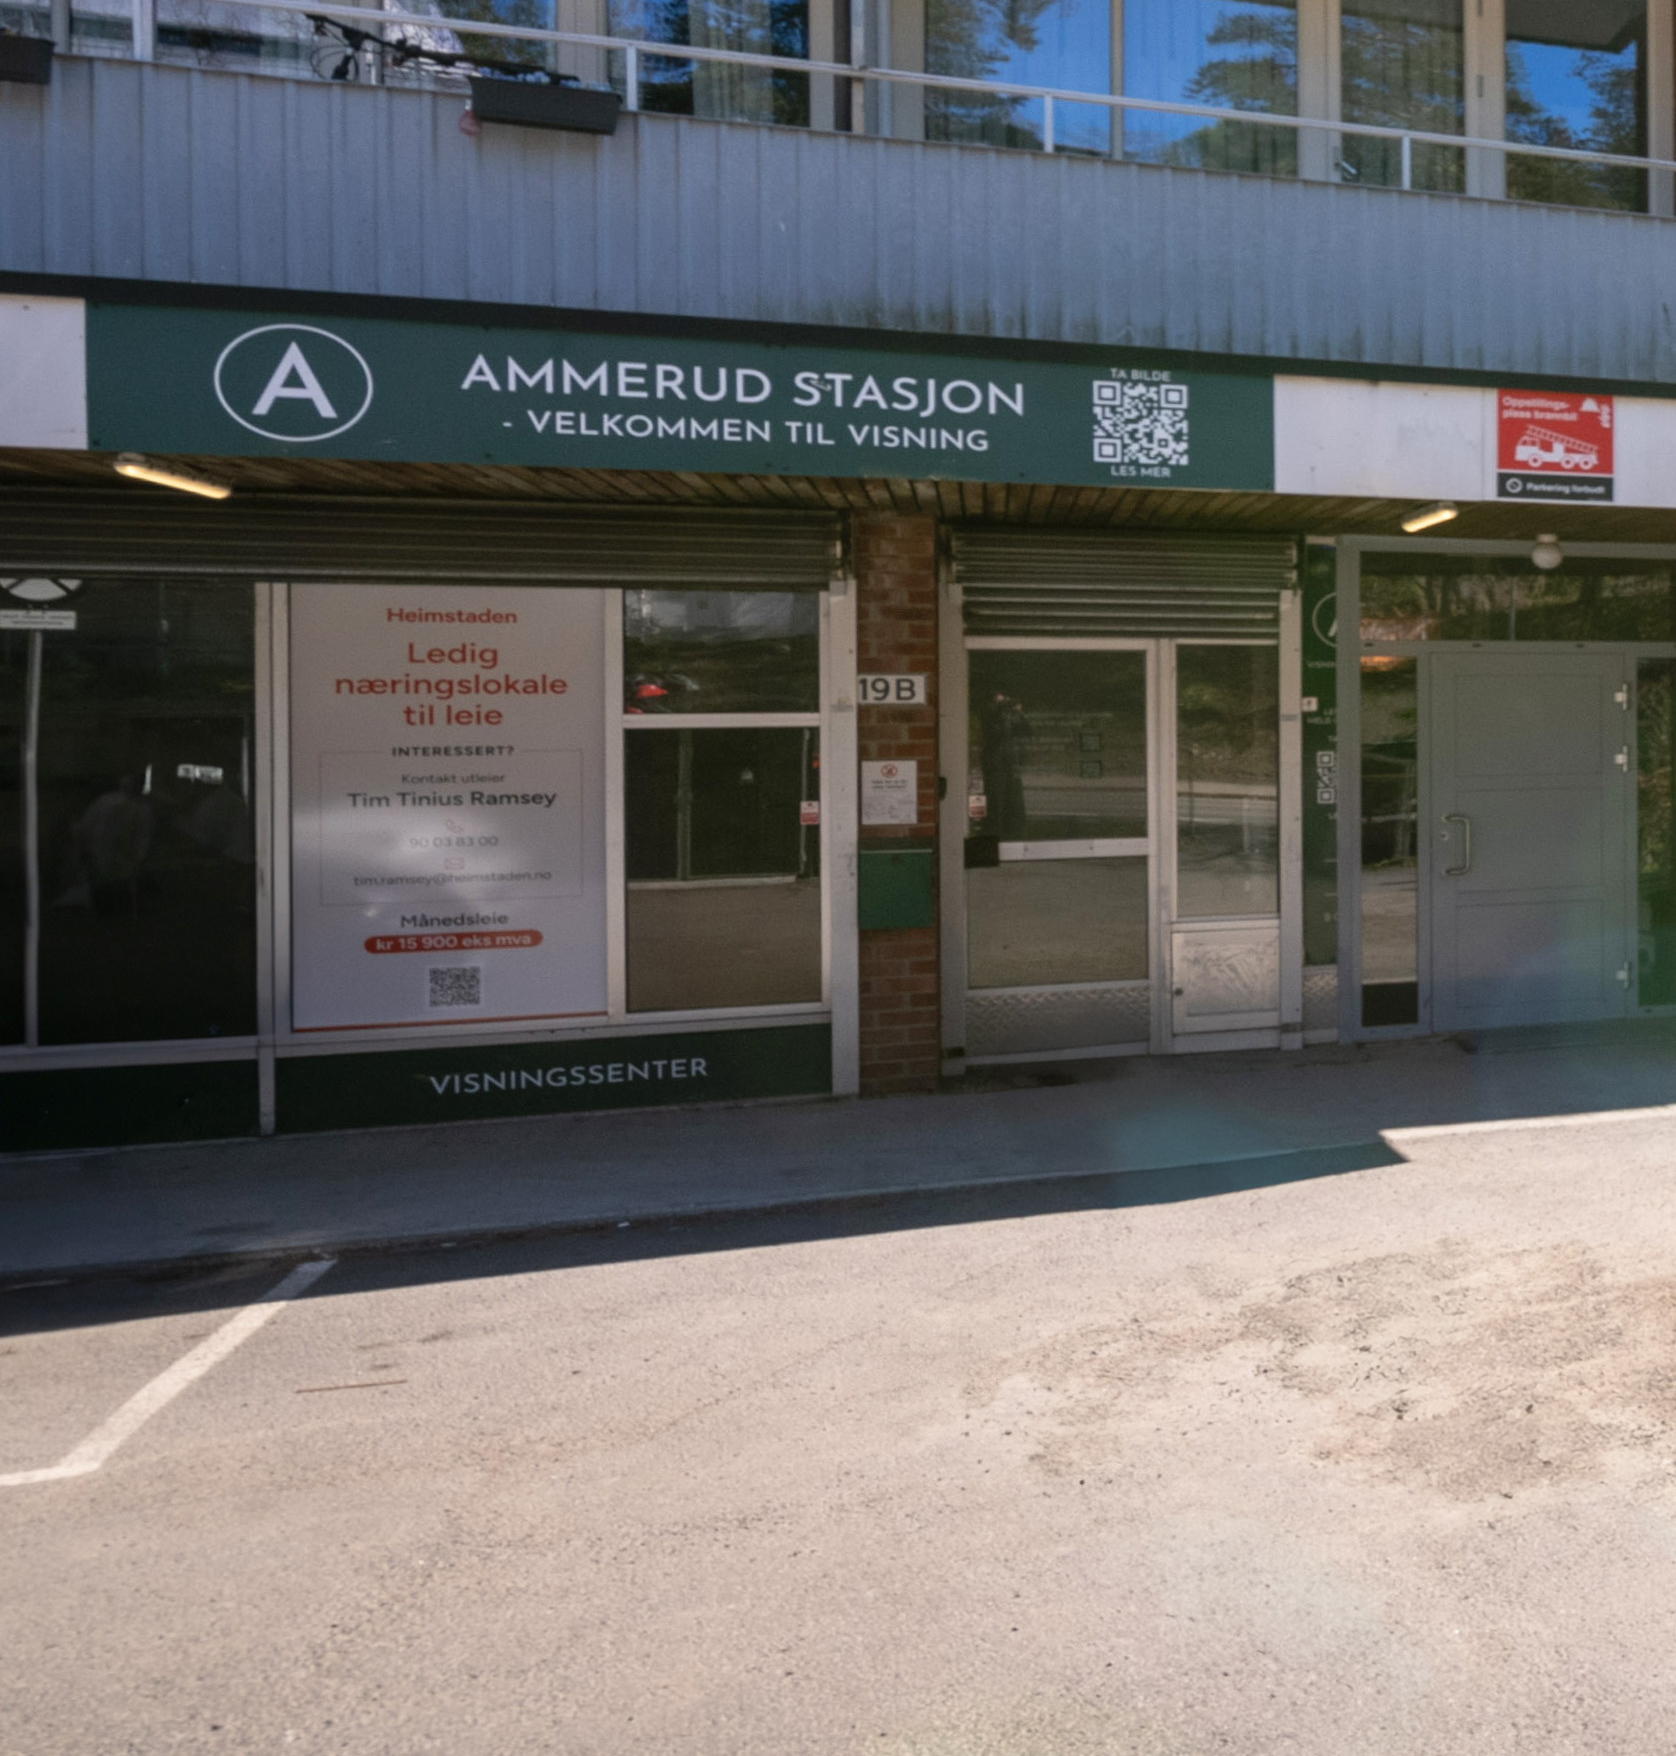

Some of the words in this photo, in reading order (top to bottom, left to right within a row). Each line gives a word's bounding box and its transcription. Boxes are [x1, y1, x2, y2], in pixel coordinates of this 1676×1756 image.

[252, 341, 338, 418] A
[1110, 368, 1127, 380] TA
[1131, 369, 1171, 382] BILDE
[461, 353, 772, 403] AMMERUD
[793, 371, 1024, 417] STASJON
[527, 409, 771, 442] VELKOMMEN
[785, 421, 835, 445] TIL
[848, 424, 989, 452] VISNING
[1111, 465, 1137, 477] LES
[1140, 466, 1171, 478] MER
[1526, 482, 1570, 495] Parkering
[387, 608, 517, 624] Heimstaden
[408, 643, 498, 669] Ledig
[335, 674, 568, 700] næringslokale
[403, 705, 434, 726] til
[446, 705, 503, 726] leie
[392, 746, 514, 757] INTERESSERT?
[401, 774, 457, 784] Kontakt
[461, 773, 505, 784] utleier
[348, 793, 390, 807] Tim
[396, 792, 464, 807] Tinius
[470, 791, 557, 809] Ramsey
[400, 912, 509, 928] Månedsleie
[376, 939, 394, 951] kr
[399, 938, 417, 950] 15
[422, 936, 457, 950] 900
[462, 934, 492, 947] eks
[496, 935, 532, 946] mva
[430, 1058, 708, 1094] VISNINGSSENTER
